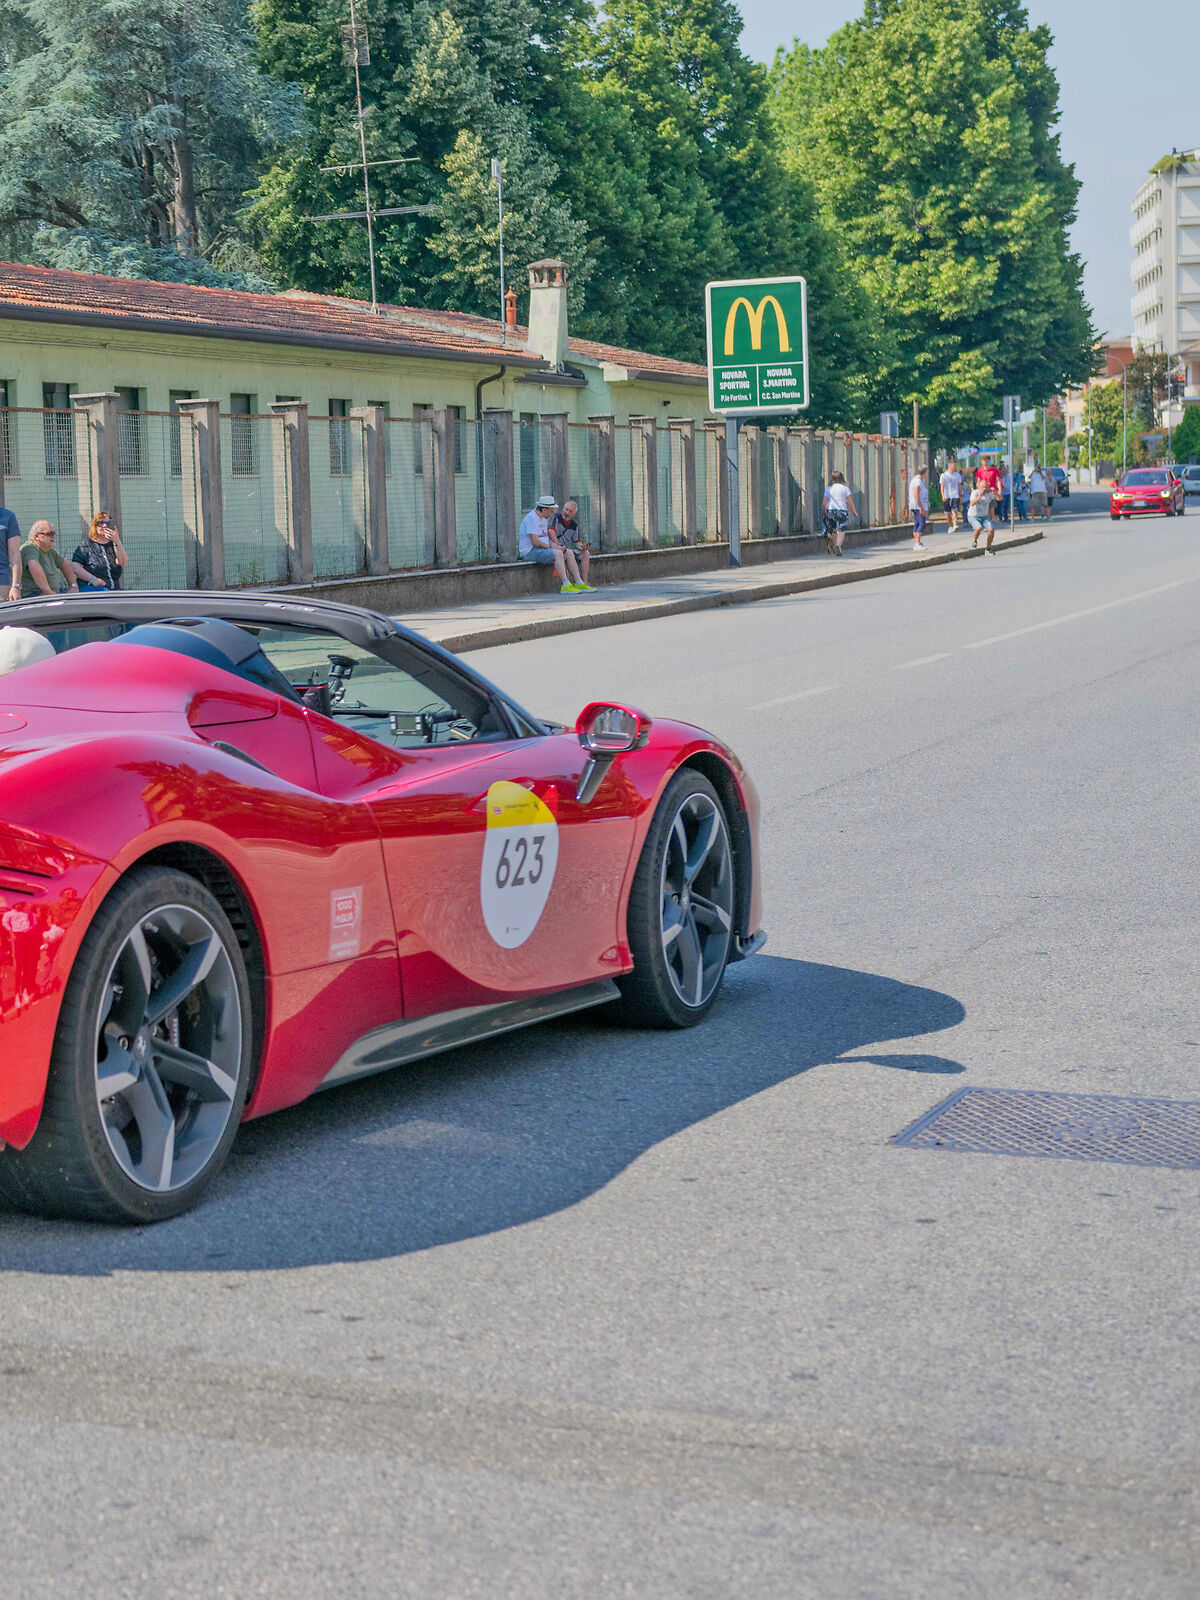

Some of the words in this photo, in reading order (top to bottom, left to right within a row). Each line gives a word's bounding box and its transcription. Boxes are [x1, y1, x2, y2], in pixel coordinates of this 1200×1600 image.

[721, 370, 747, 379] NOVARA
[766, 368, 792, 377] NOVARA
[719, 380, 750, 390] SPORTING
[762, 378, 797, 388] S.MARTINO
[772, 391, 781, 399] San
[781, 391, 801, 399] Martino
[496, 835, 545, 889] 623
